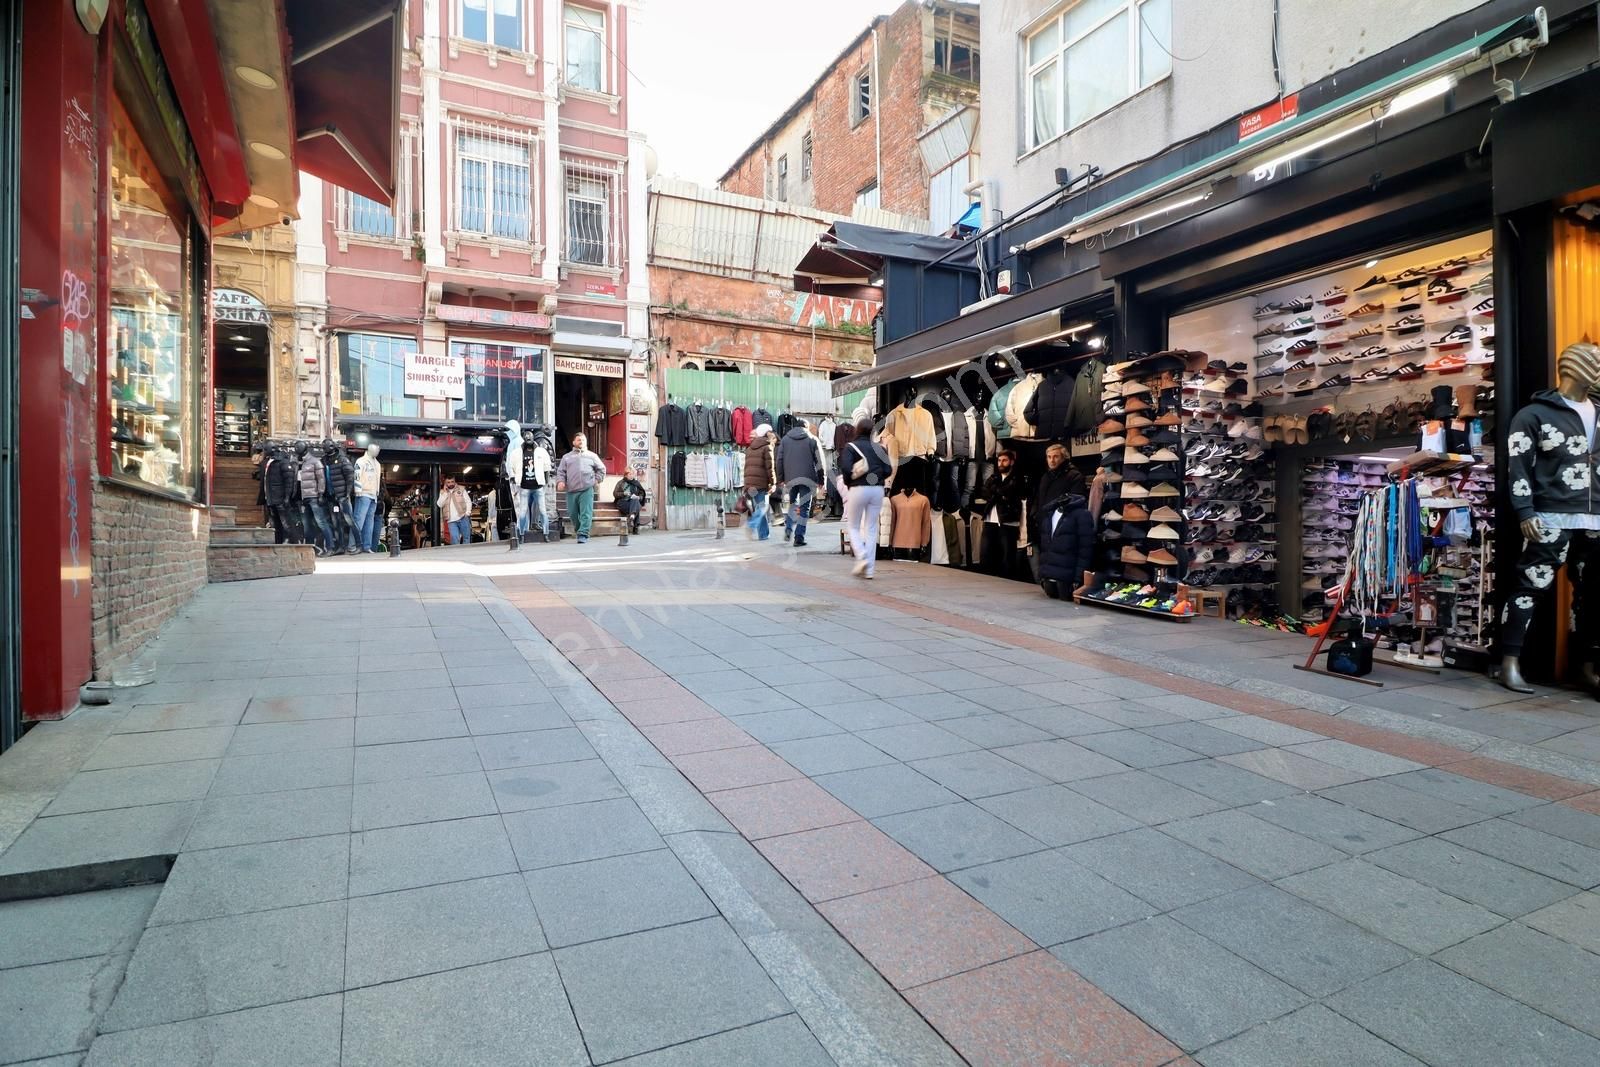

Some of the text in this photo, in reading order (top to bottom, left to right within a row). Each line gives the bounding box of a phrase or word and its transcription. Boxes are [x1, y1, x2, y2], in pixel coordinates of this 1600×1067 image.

[1241, 114, 1262, 130] YASA
[555, 359, 622, 375] BAHÇEMİZ VARDIR
